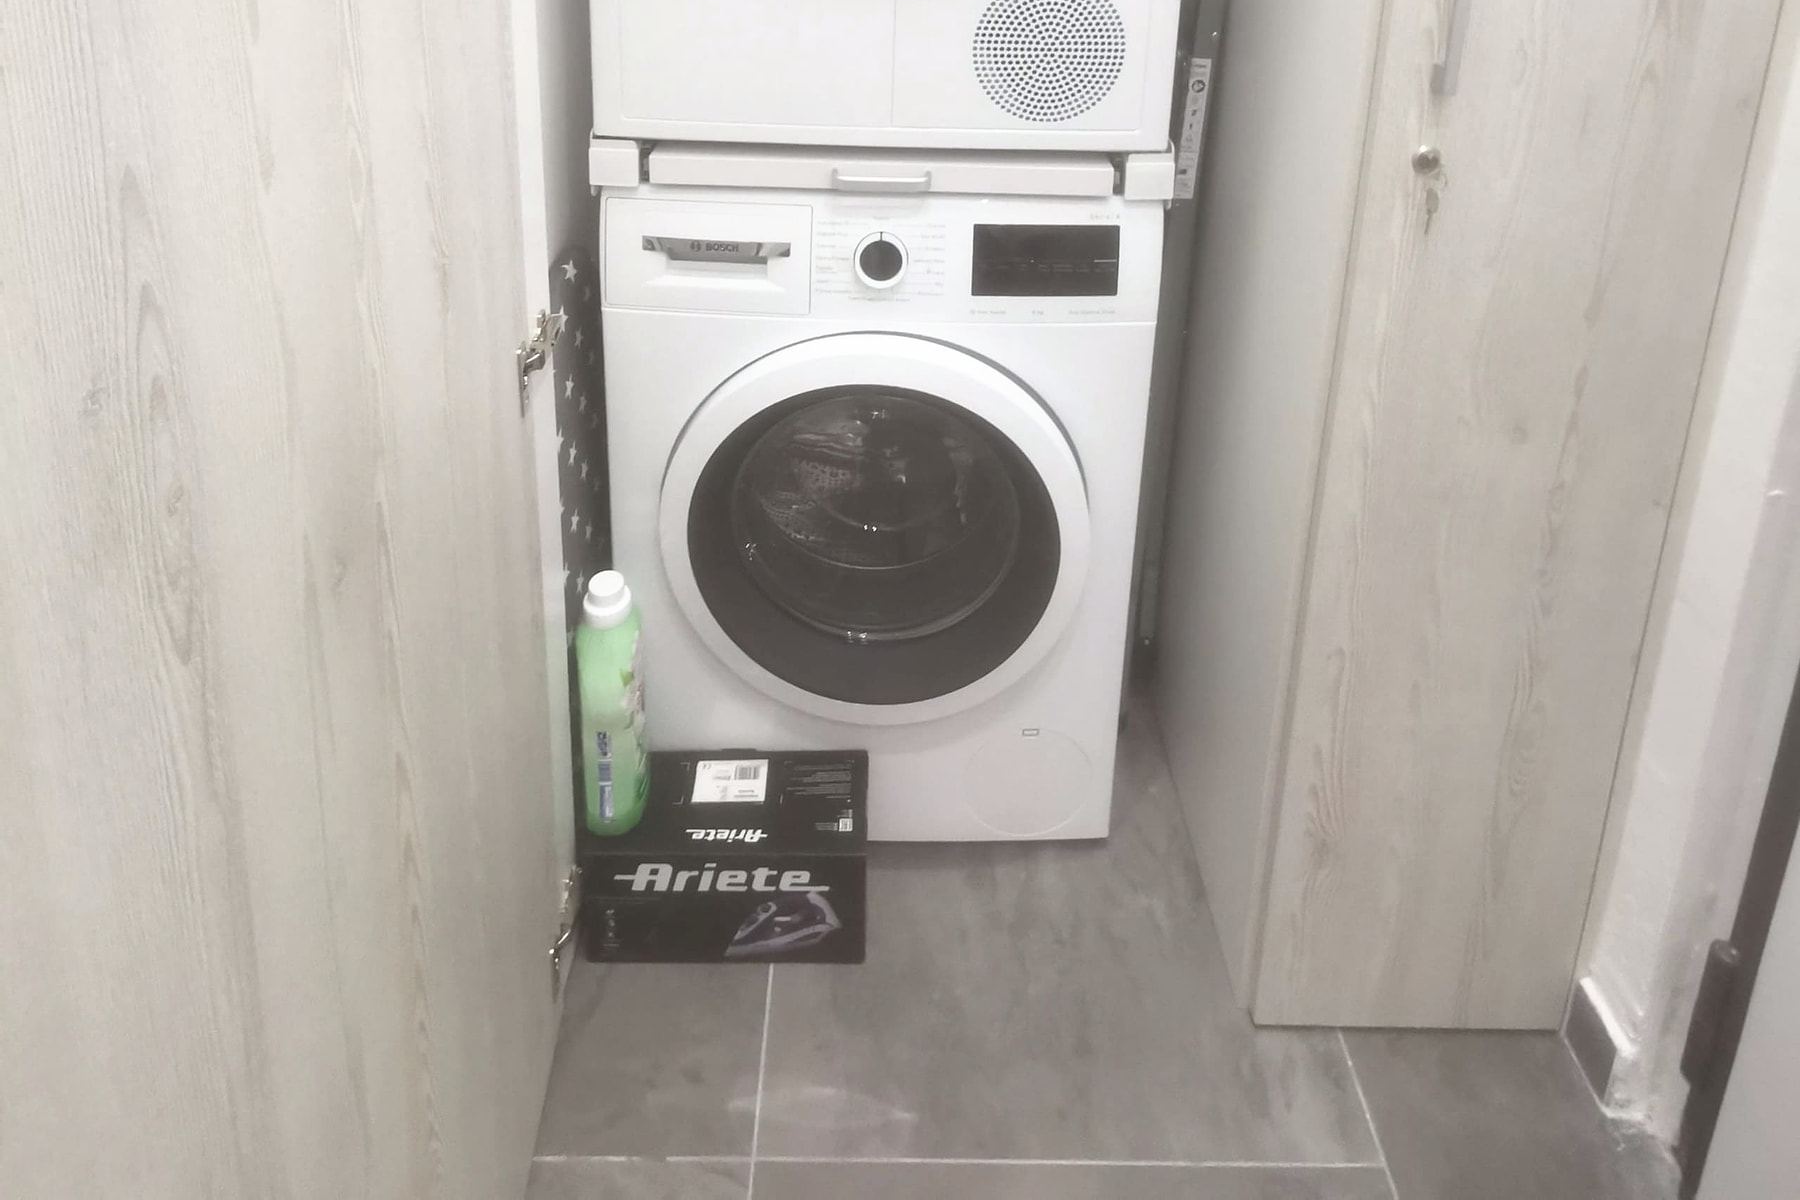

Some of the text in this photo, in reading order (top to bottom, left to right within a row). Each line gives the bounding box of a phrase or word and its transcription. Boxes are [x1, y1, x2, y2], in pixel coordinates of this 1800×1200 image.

[705, 242, 739, 253] BOSCH
[685, 828, 768, 843] Ariete
[613, 862, 830, 892] Ariete
